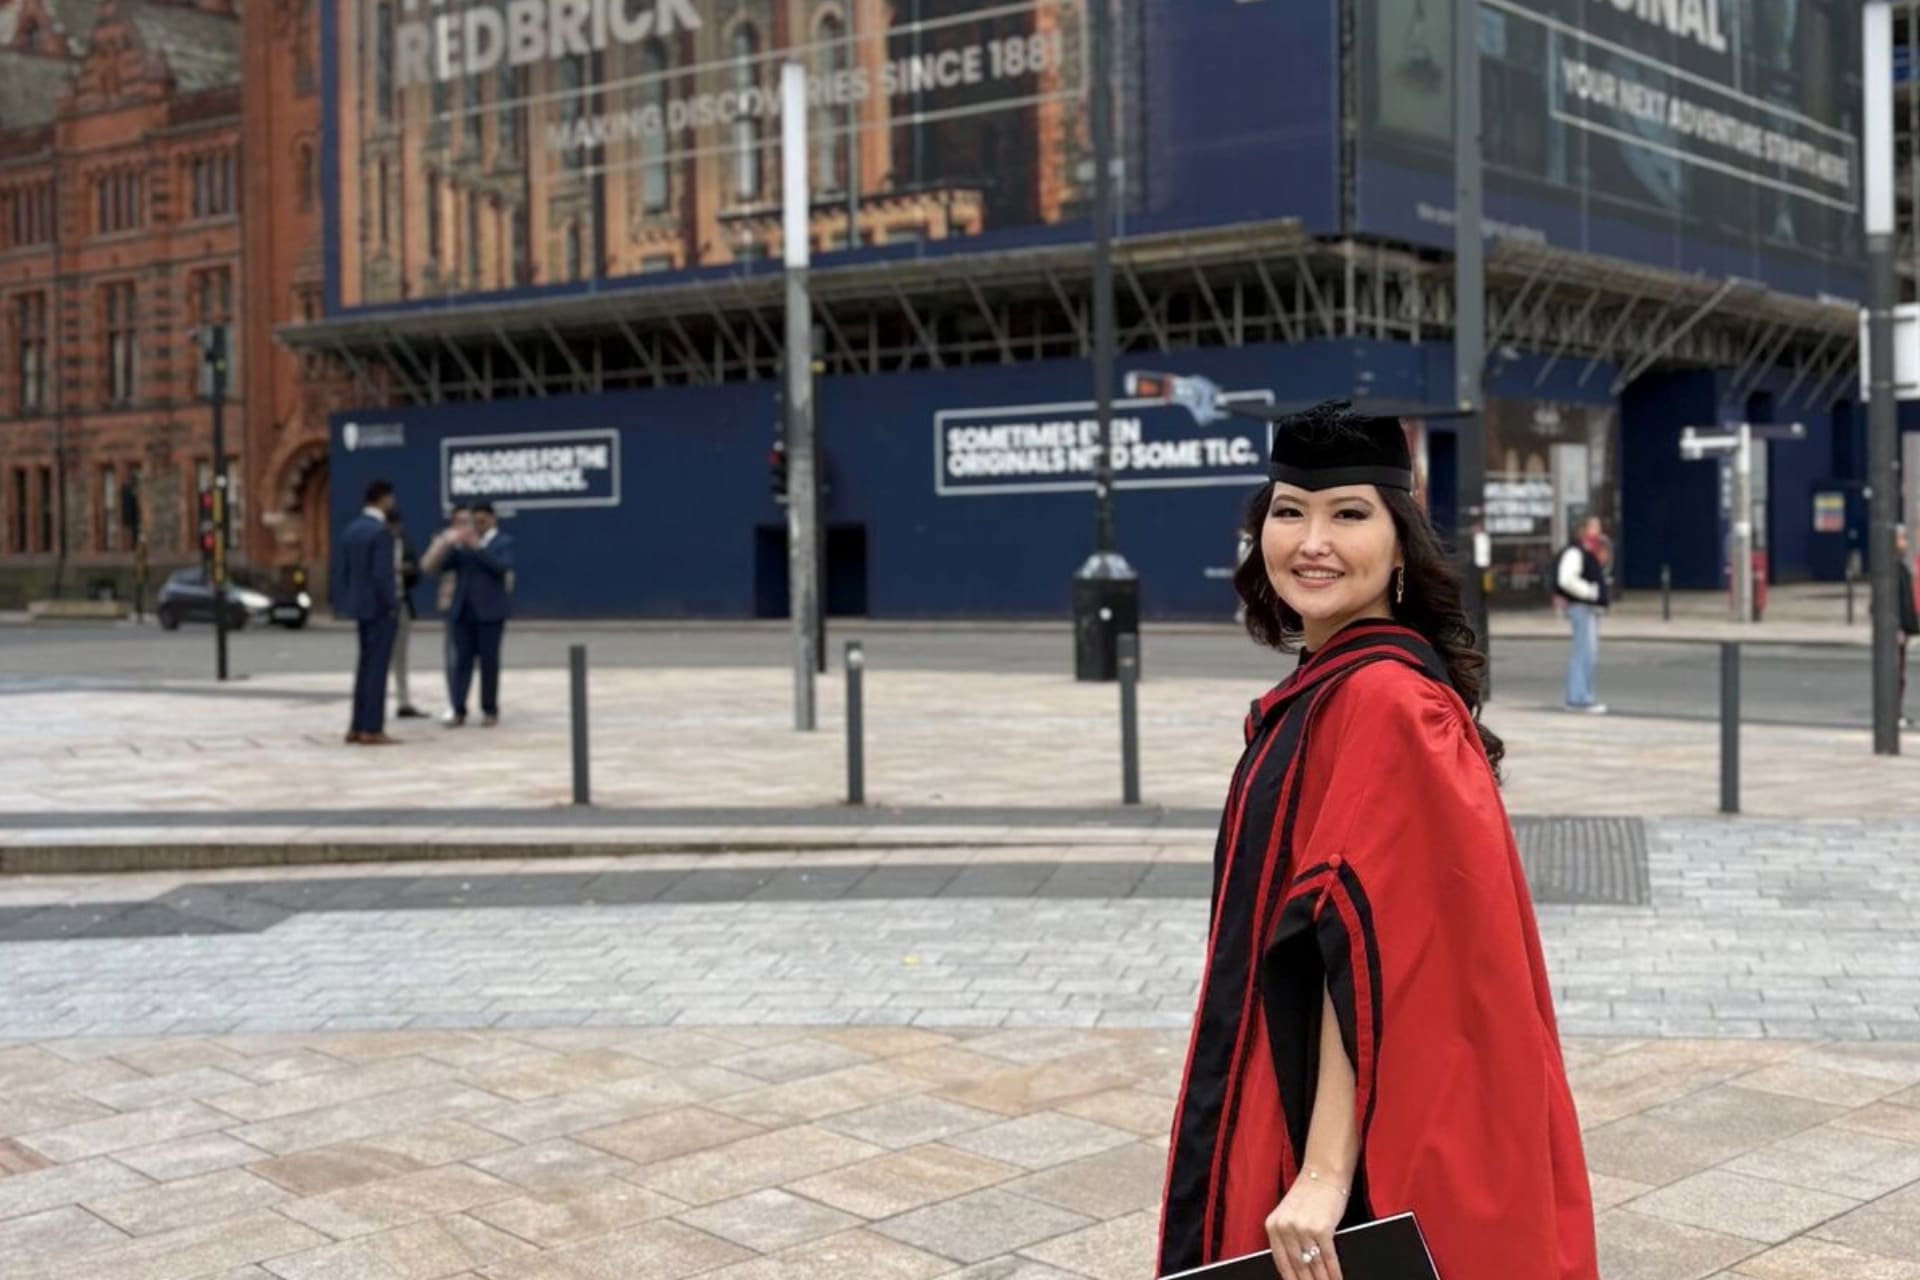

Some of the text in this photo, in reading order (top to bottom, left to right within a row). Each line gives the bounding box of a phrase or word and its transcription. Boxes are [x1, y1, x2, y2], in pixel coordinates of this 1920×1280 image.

[669, 68, 870, 133] DISCOVRIES
[884, 45, 983, 98] SINCE
[1561, 57, 1617, 109] YOUR
[1619, 79, 1668, 125] NEXT
[1669, 96, 1763, 160] ADVENTURE
[948, 421, 1077, 451] SOMETIMES
[948, 446, 1067, 477] ORIGINALS
[1131, 440, 1203, 470] SOME
[1203, 436, 1260, 466] TLC.
[451, 444, 608, 475] APOLOGIES FOR THE
